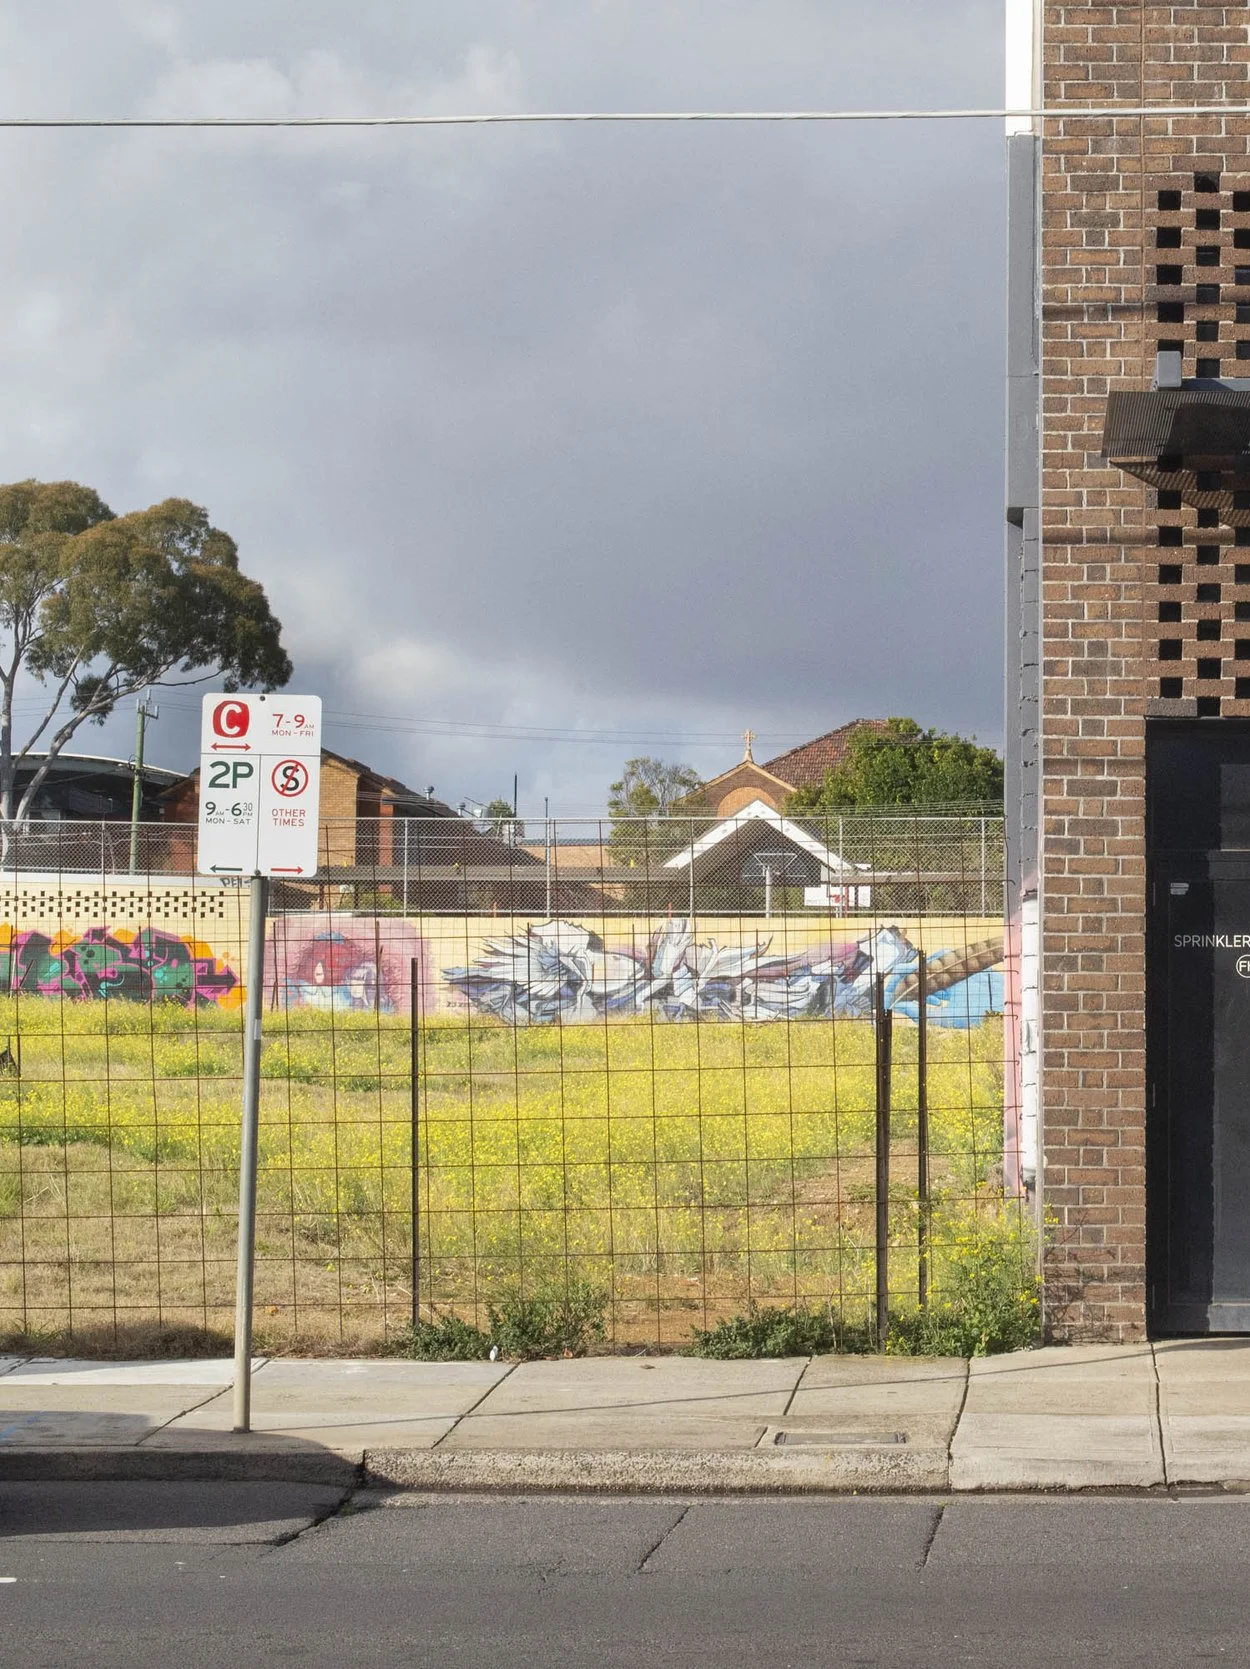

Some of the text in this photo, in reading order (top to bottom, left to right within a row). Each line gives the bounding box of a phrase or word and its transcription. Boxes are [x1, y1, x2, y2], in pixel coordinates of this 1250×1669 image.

[220, 703, 242, 735] C
[208, 760, 254, 789] 2P
[271, 808, 306, 817] OTHER
[273, 818, 305, 827] TIMES
[1174, 934, 1250, 948] SPRINKLER
